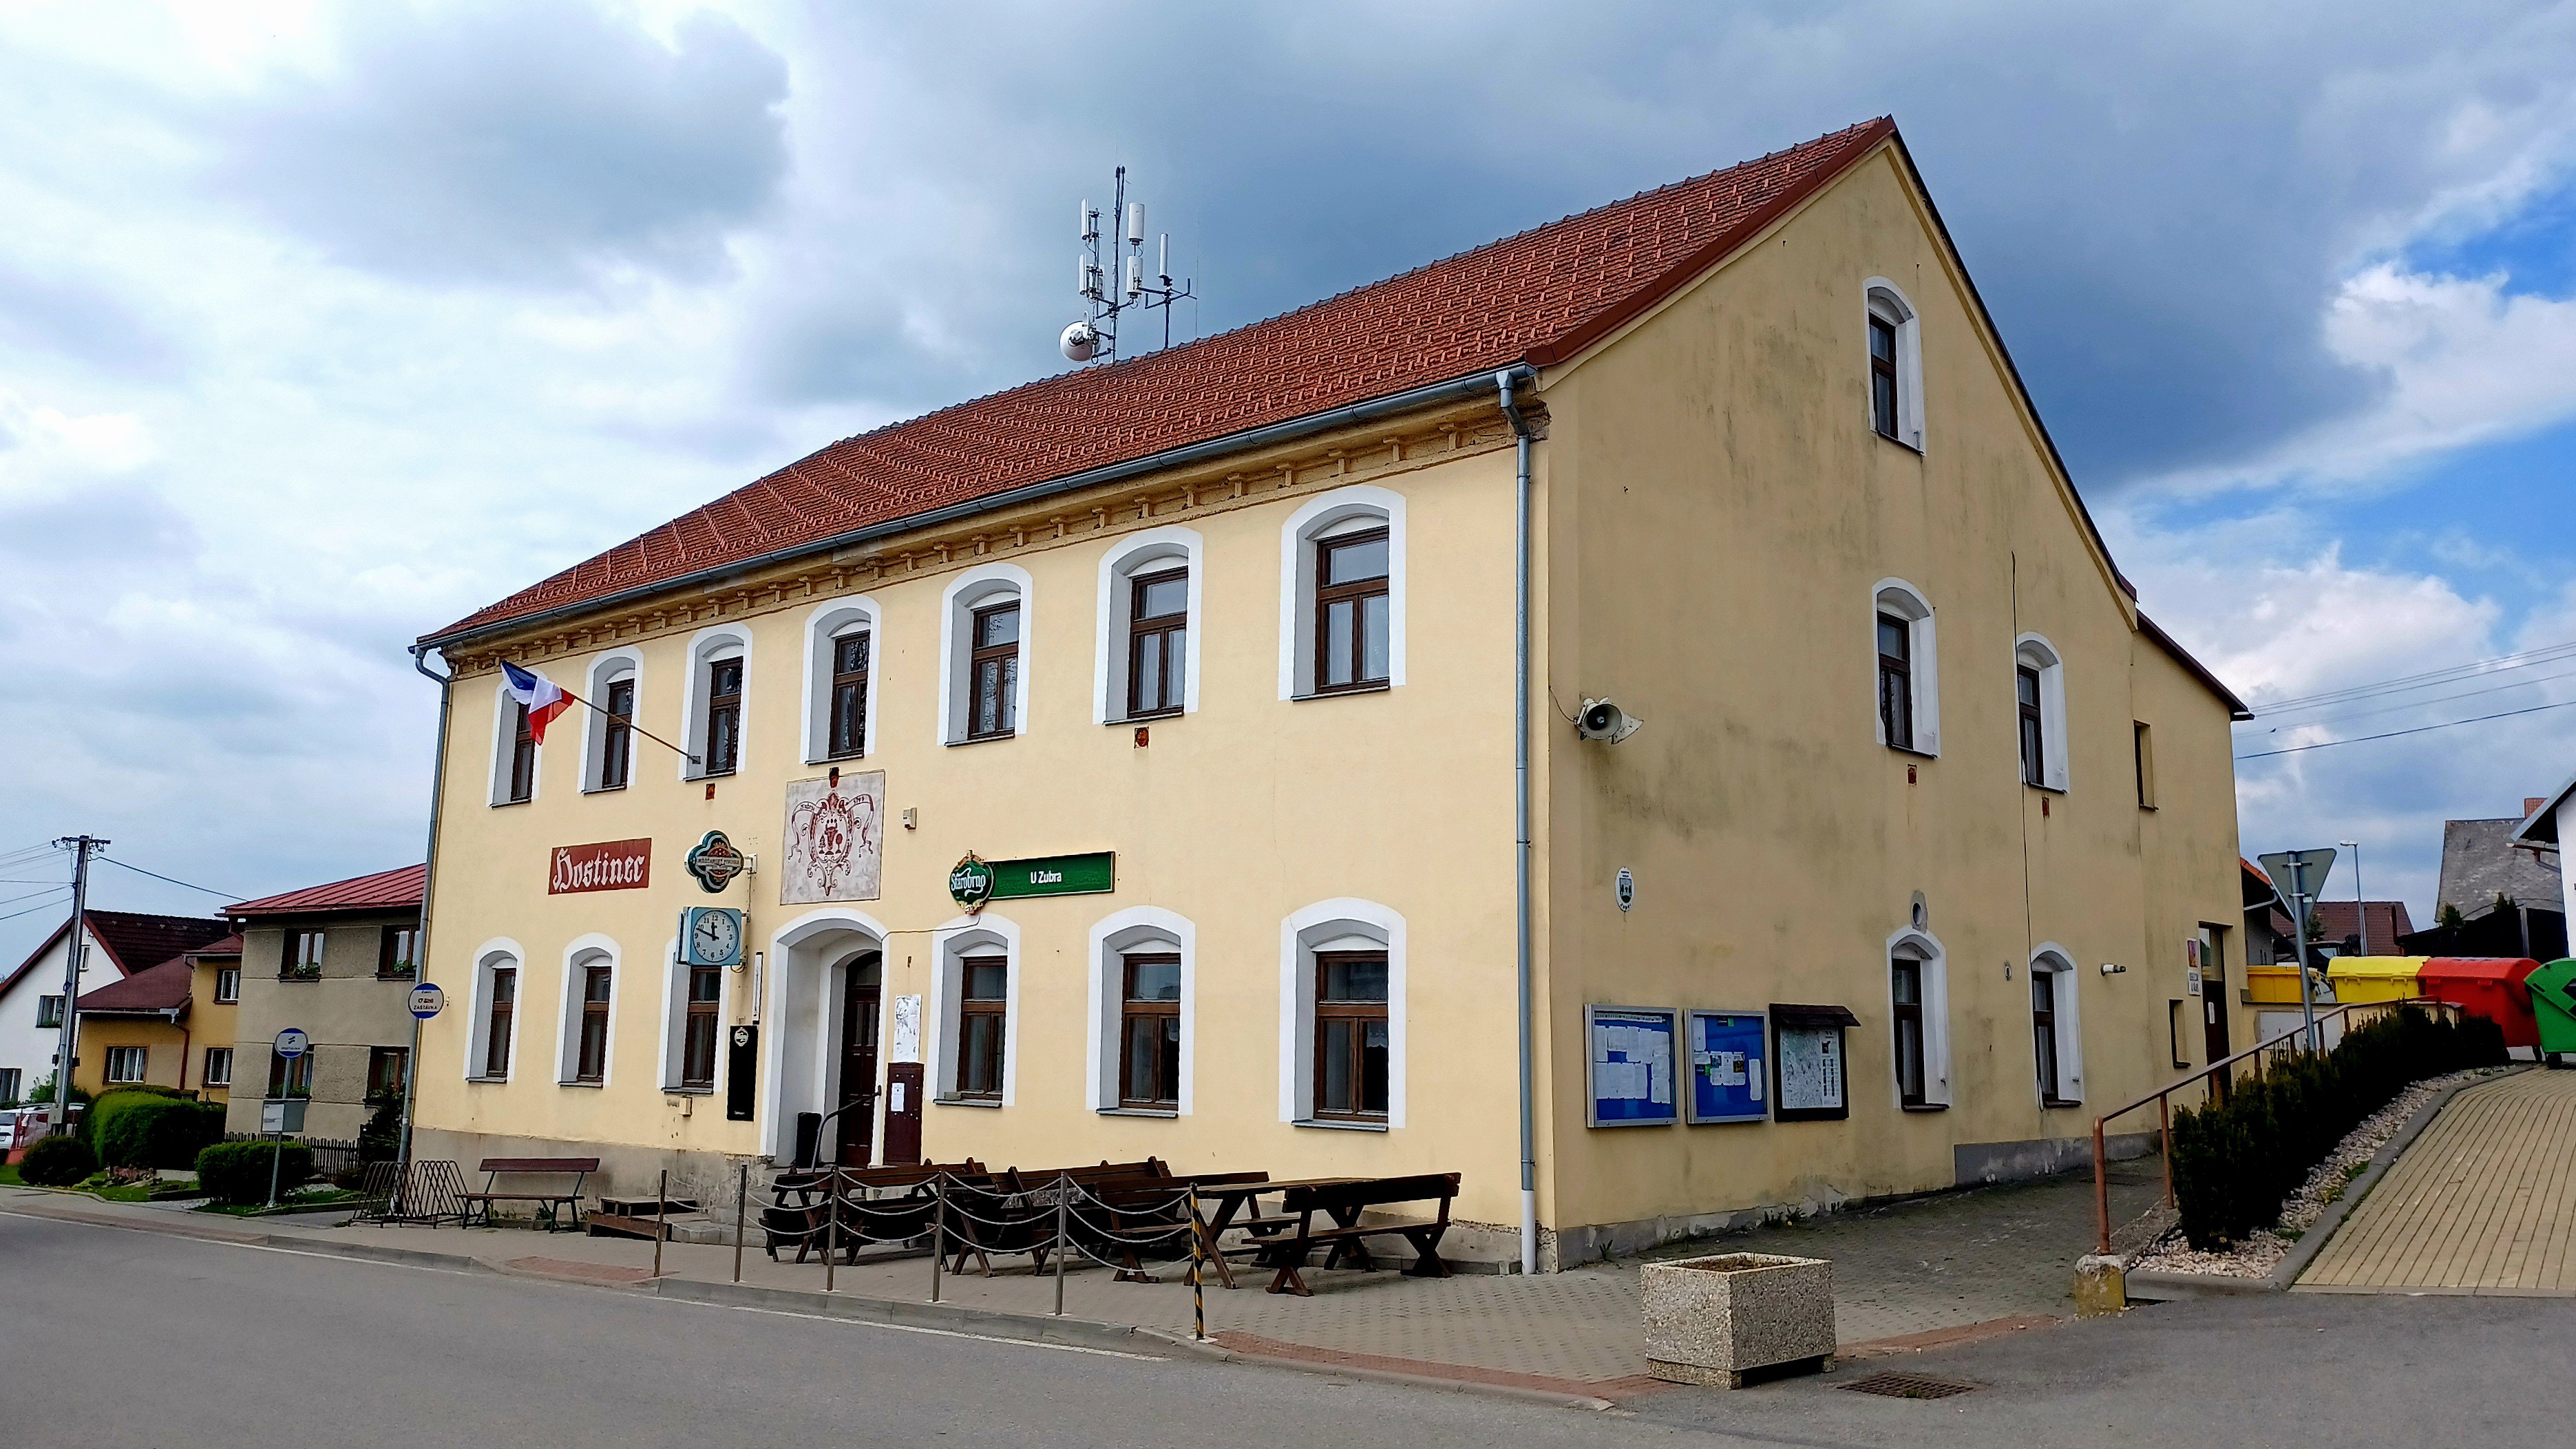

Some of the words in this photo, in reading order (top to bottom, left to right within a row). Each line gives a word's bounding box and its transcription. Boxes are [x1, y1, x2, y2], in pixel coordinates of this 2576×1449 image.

[552, 847, 646, 893] Hostinec
[951, 867, 986, 898] Starobrno
[1031, 871, 1037, 884] U
[1038, 869, 1062, 884] Zubra
